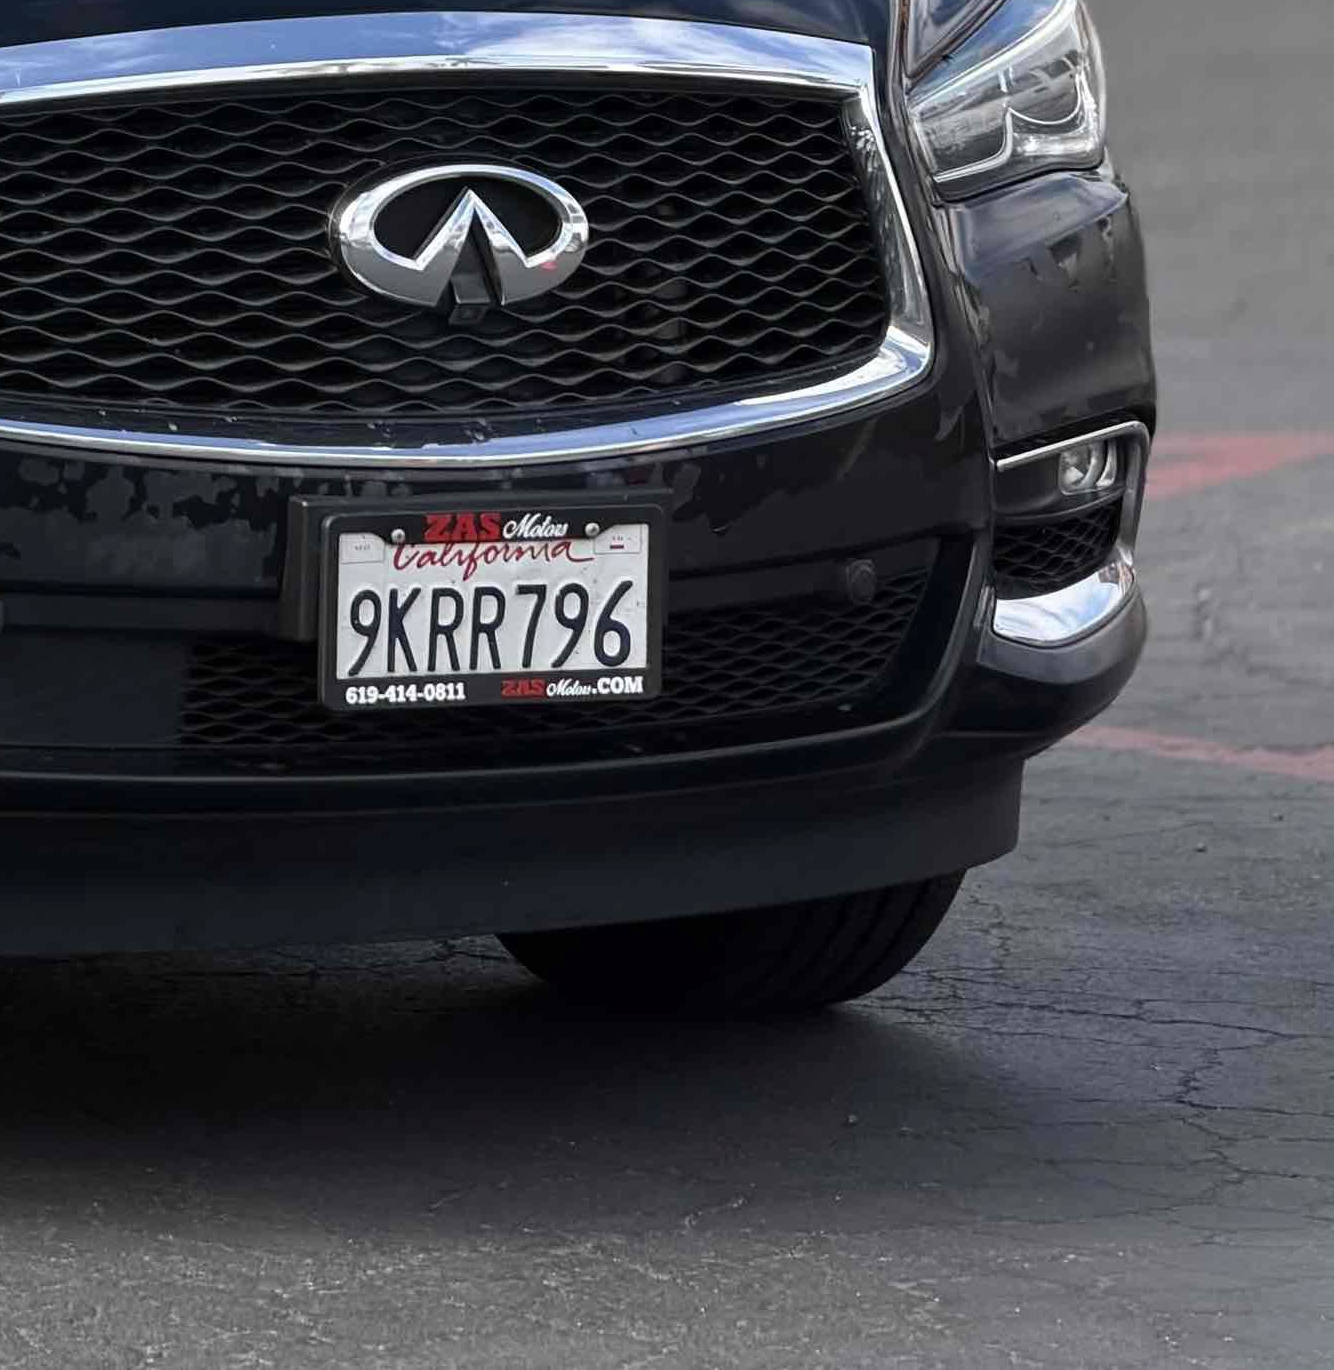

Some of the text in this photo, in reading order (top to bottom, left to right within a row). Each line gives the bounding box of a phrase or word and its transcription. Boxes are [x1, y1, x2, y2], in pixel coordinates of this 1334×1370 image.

[422, 512, 569, 541] ZAS Motors
[393, 541, 594, 582] California
[348, 579, 634, 677] 9KRR796
[345, 682, 466, 705] 619-414-0811
